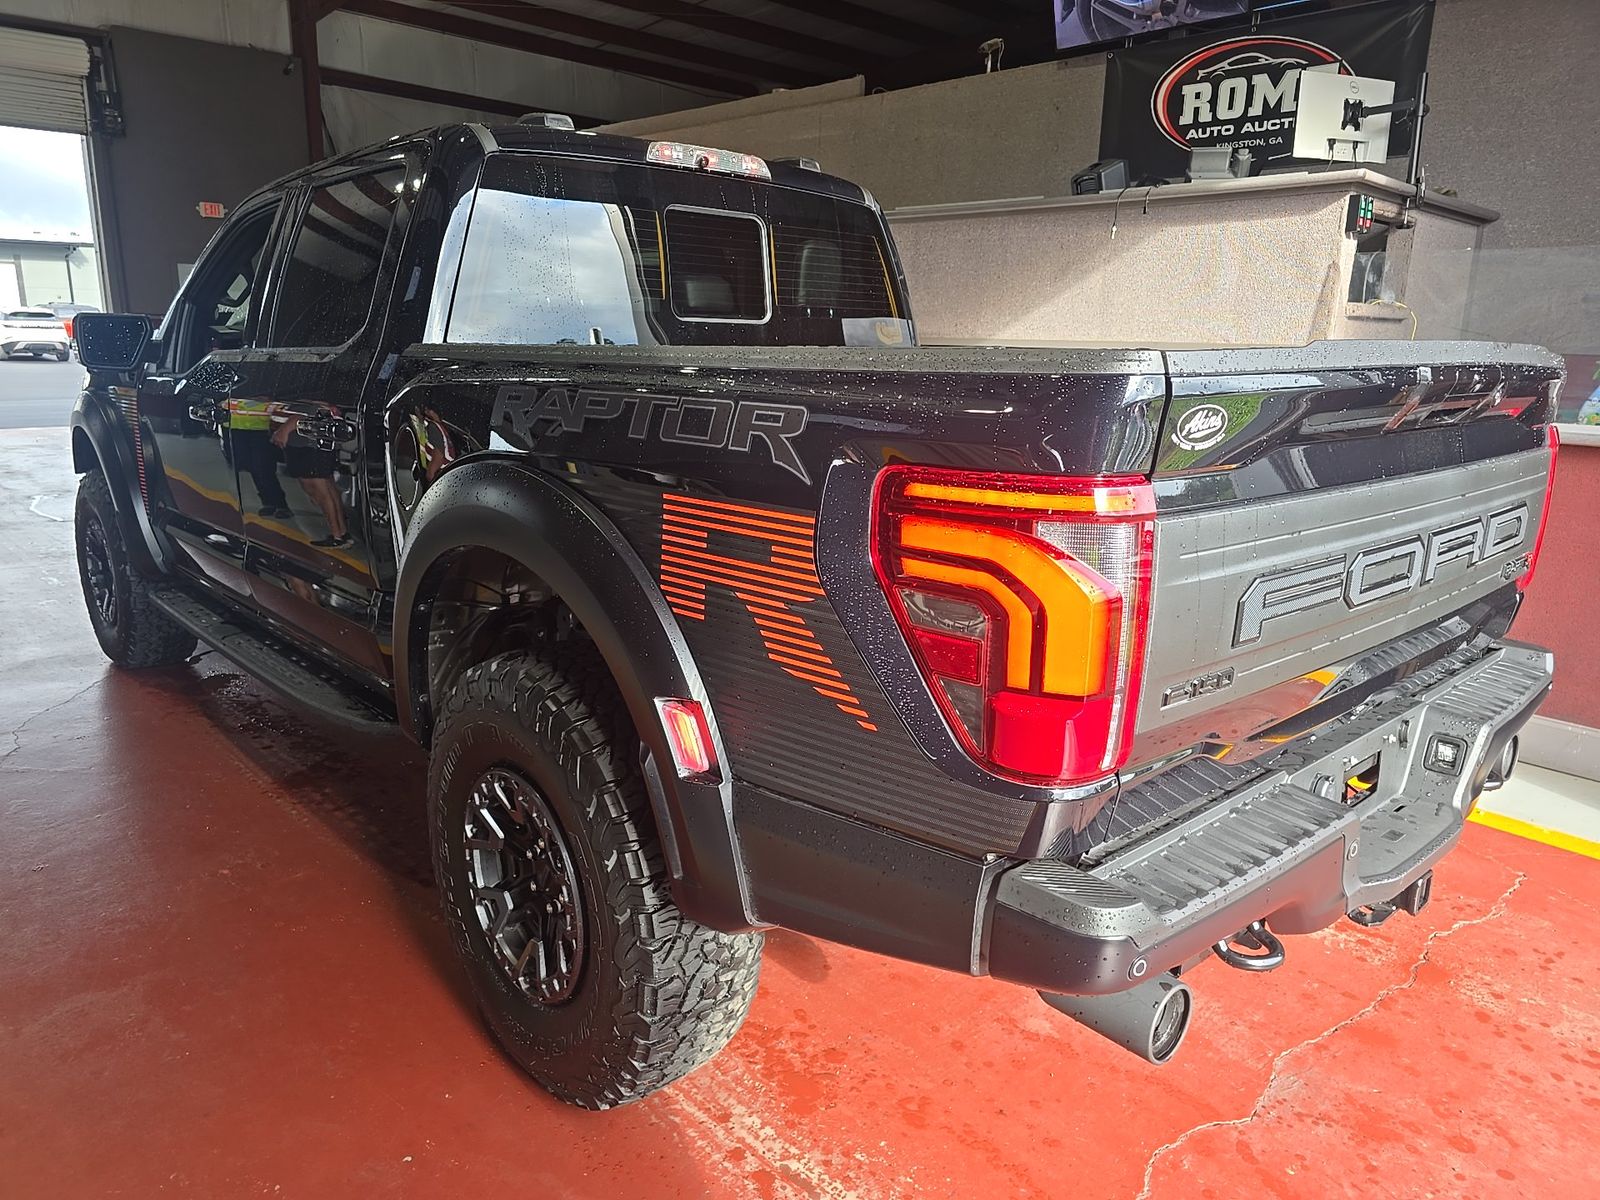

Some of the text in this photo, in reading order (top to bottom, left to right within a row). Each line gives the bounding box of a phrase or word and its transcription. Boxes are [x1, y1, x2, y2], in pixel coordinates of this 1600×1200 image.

[1179, 68, 1301, 125] ROM
[1186, 117, 1295, 140] AUTO AUCTI
[1216, 136, 1284, 149] KINGSTON, GA
[204, 203, 220, 216] EXIT
[491, 385, 813, 486] RAPTOR
[1232, 501, 1530, 648] FORD
